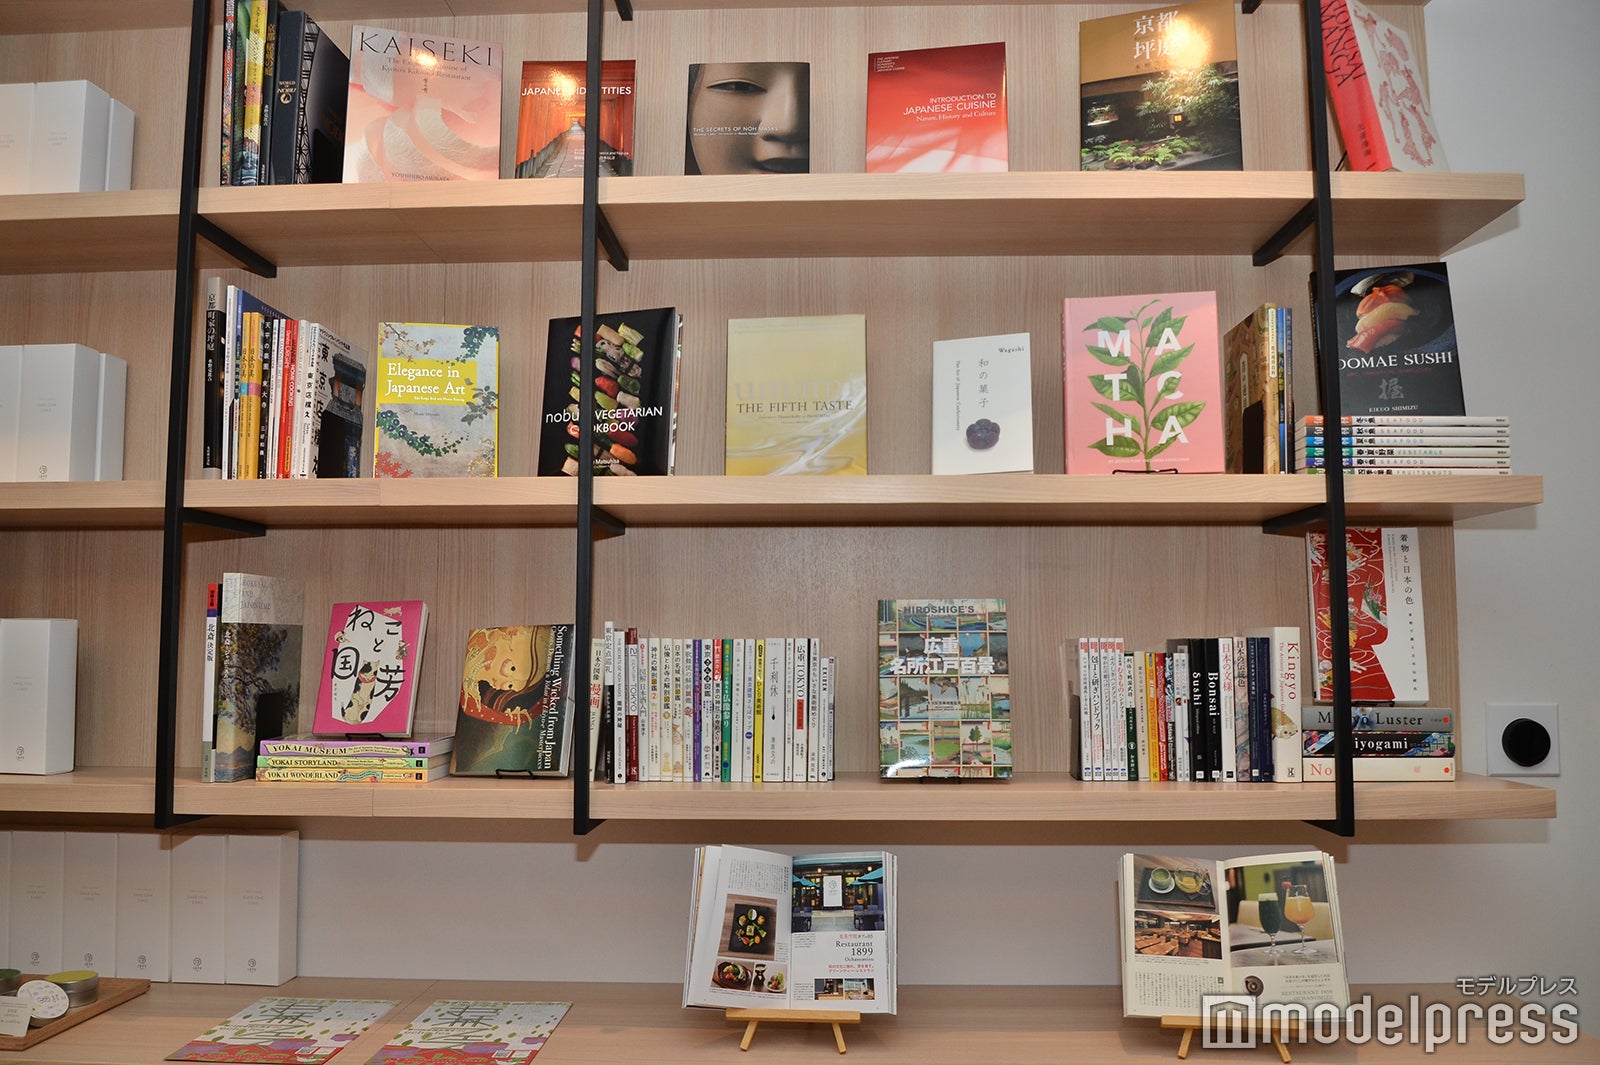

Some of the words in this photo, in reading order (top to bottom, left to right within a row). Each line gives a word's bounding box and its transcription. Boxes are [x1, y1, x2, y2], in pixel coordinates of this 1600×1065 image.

[1133, 10, 1179, 35] 京都
[360, 32, 492, 66] KAISEKI
[522, 86, 573, 96] JAPANE
[576, 86, 632, 95] IDTITIES
[930, 94, 984, 103] INTRODUCTION
[903, 104, 952, 116] JAPANESE
[956, 100, 997, 110] CUISINE
[938, 113, 960, 121] History
[1339, 355, 1398, 370] DOMAE
[1403, 351, 1453, 366] SUSHI
[387, 362, 443, 380] Elegance
[447, 366, 460, 378] in
[385, 380, 440, 397] Japanese
[443, 381, 466, 395] Art
[978, 358, 989, 408] 和の菓子
[594, 406, 663, 420] VEGETARIAN
[736, 403, 763, 413] THE
[769, 401, 807, 412] FIFTH
[812, 400, 853, 411] TASTE
[569, 421, 636, 434] CKBOOK
[1399, 533, 1414, 605] 着物と日本の色
[903, 605, 975, 615] HIROSHIGE'S
[550, 625, 568, 676] Something
[924, 636, 959, 654] 広重
[890, 656, 995, 675] 名所江戸百景
[1222, 643, 1232, 692] 日本の文様
[1287, 642, 1300, 700] Kingyo
[769, 656, 779, 697] 千利休
[797, 664, 805, 698] TOKYO
[549, 677, 563, 716] Wicked
[1192, 671, 1203, 706] Sushi
[1207, 672, 1221, 717] Bonsai
[630, 684, 638, 712] TOKYO
[547, 716, 558, 740] from
[1376, 712, 1423, 726] Luster
[272, 744, 301, 752] YOKAI
[303, 745, 347, 756] MUSEUM
[1354, 737, 1408, 751] iyogami
[271, 758, 293, 766] YOKAI
[544, 740, 556, 769] Japan
[266, 771, 289, 779] YOKAI
[290, 771, 339, 780] WONDERLAND
[835, 940, 873, 948] Restaurant
[852, 947, 873, 956] 1899
